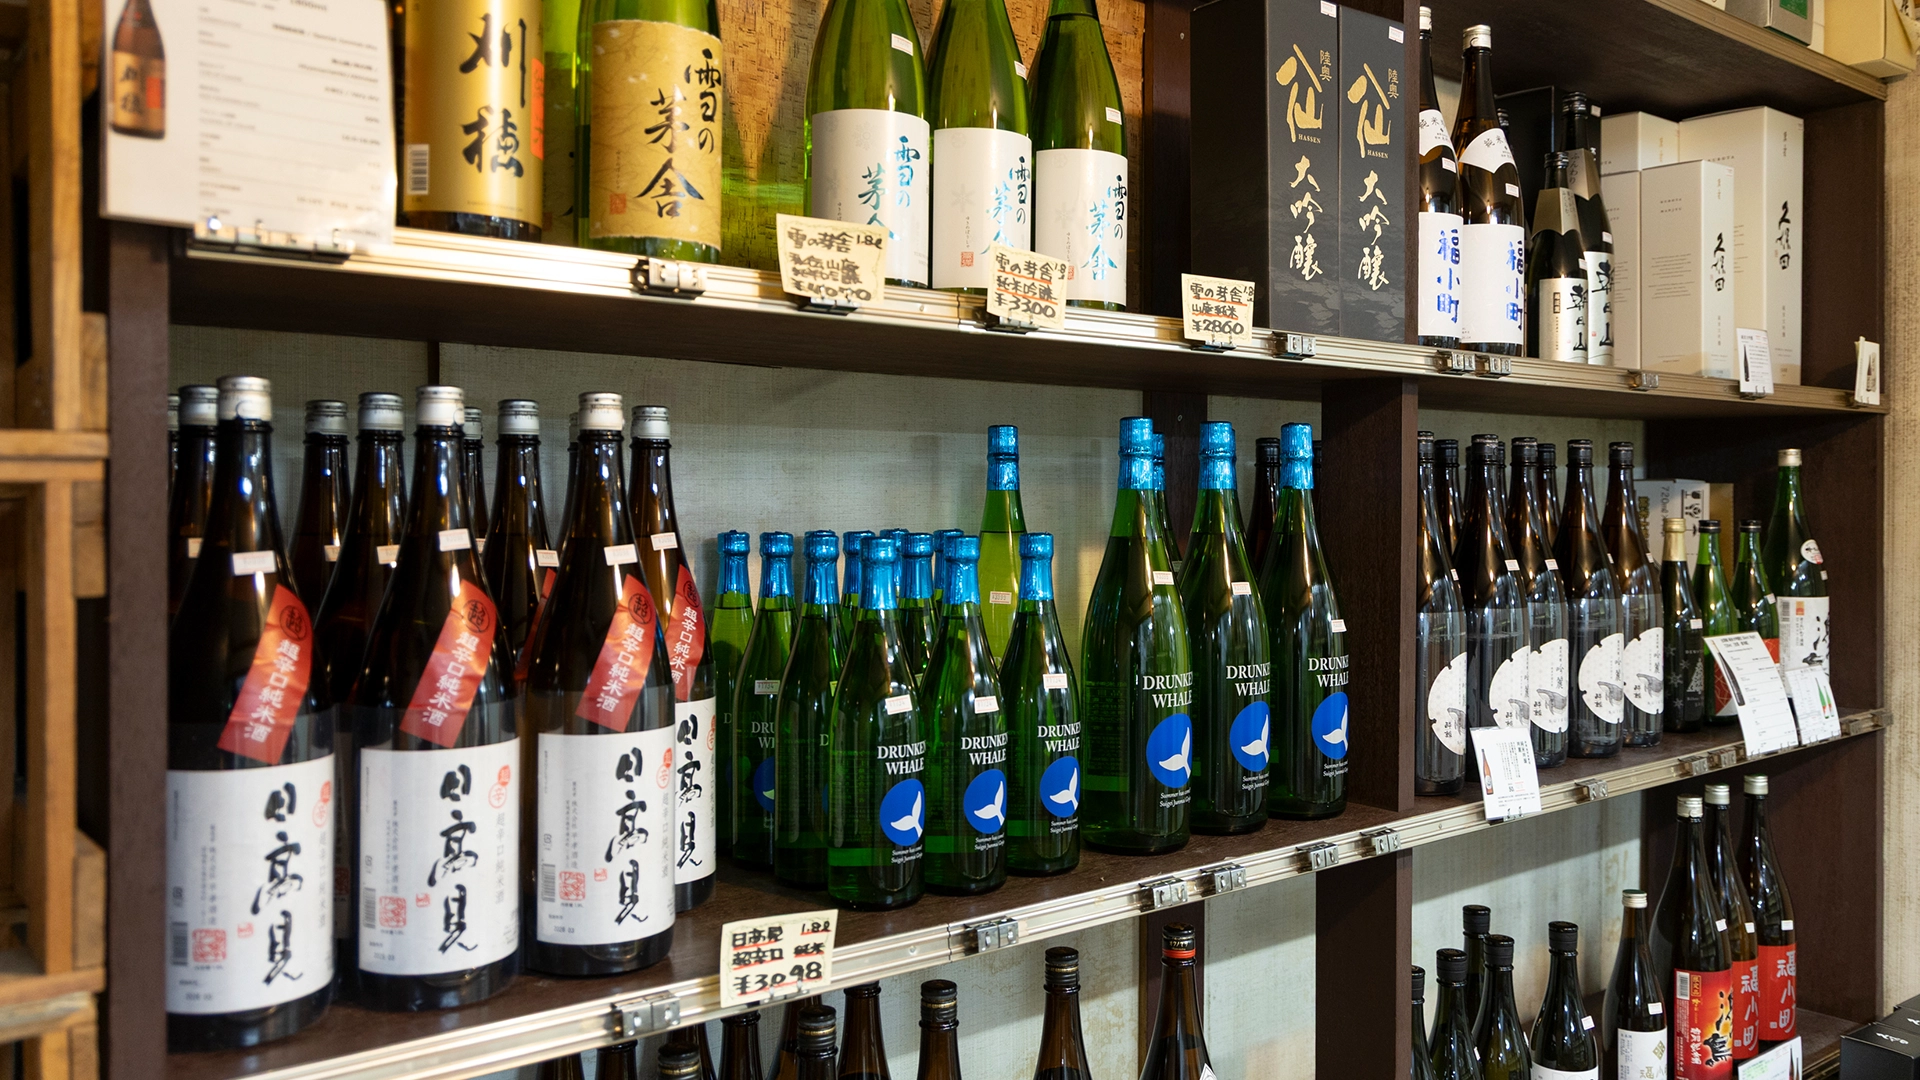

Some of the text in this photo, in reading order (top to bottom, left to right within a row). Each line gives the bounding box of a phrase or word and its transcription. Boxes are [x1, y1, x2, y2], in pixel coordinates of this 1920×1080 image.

[460, 12, 527, 178] 刈穂
[684, 48, 722, 155] 雪の
[1276, 44, 1324, 143] 八仙
[1319, 50, 1332, 82] 陸奥
[1387, 68, 1400, 99] 陸奥
[1298, 134, 1321, 144] HASSEN
[1347, 63, 1391, 158] 八仙
[1367, 149, 1389, 159] HASSEN
[1289, 155, 1324, 281] 大吟醸
[1358, 170, 1390, 292] 大吟醸
[1775, 201, 1791, 270] 久保田
[1437, 228, 1461, 324] 福小町
[1711, 232, 1726, 292] 久保田
[995, 292, 1057, 318] ¥3300
[1192, 319, 1245, 335] ¥2860
[244, 639, 300, 744] 超辛口純米酒
[421, 631, 481, 728] 超辛口純米酒
[595, 622, 644, 714] 超辛口純米酒
[1152, 690, 1192, 709] WHALE
[885, 757, 924, 775] WHALE
[969, 749, 1006, 766] WHALE
[1045, 737, 1080, 752] WHALE
[677, 712, 703, 871] 日高見
[427, 764, 479, 954] 日高見
[604, 746, 649, 926] 日高見
[250, 782, 304, 986] 日高見
[732, 925, 784, 948] 日高見
[732, 947, 784, 966] 超辛口
[733, 961, 823, 995] ¥3098
[1741, 965, 1759, 1051] 福小町
[1777, 950, 1796, 1034] 福小町
